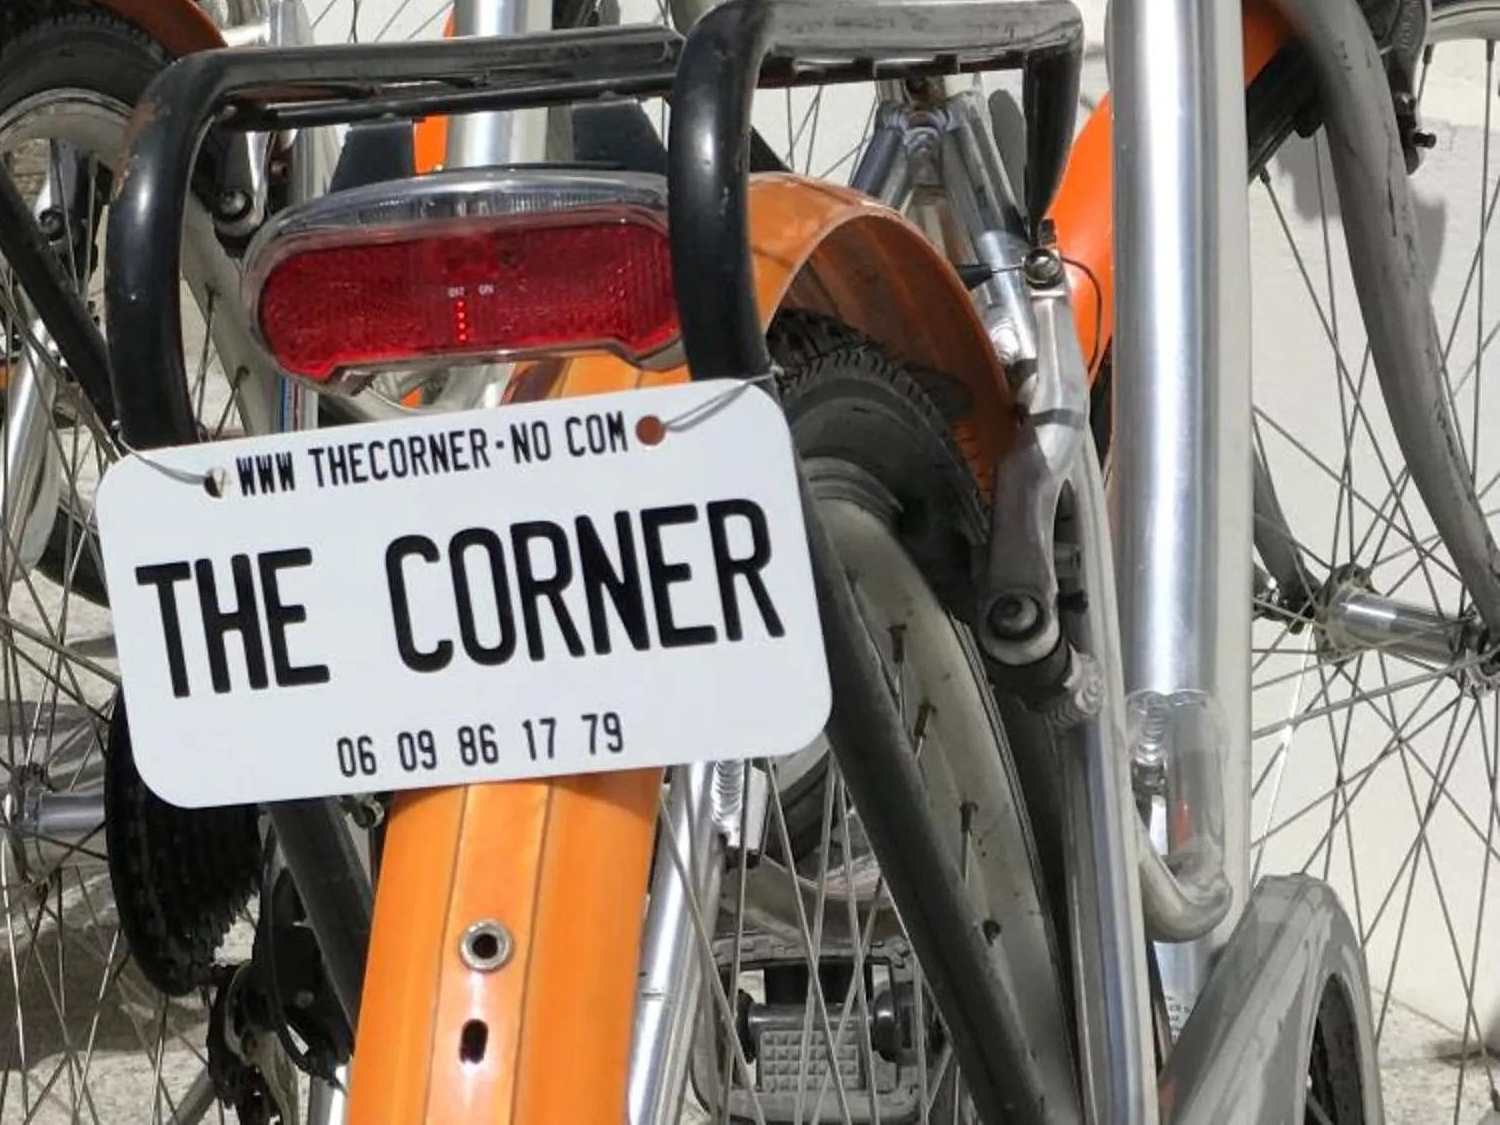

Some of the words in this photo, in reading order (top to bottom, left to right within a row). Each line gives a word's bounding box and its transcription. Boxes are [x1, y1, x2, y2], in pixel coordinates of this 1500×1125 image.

[235, 451, 296, 497] WWW
[566, 410, 629, 458] COM
[134, 547, 331, 699] THE
[385, 498, 786, 673] CORNER
[336, 736, 378, 778] 06
[397, 729, 438, 772] 09
[457, 723, 499, 767] 86
[522, 718, 557, 761] 17
[580, 712, 624, 755] 79
